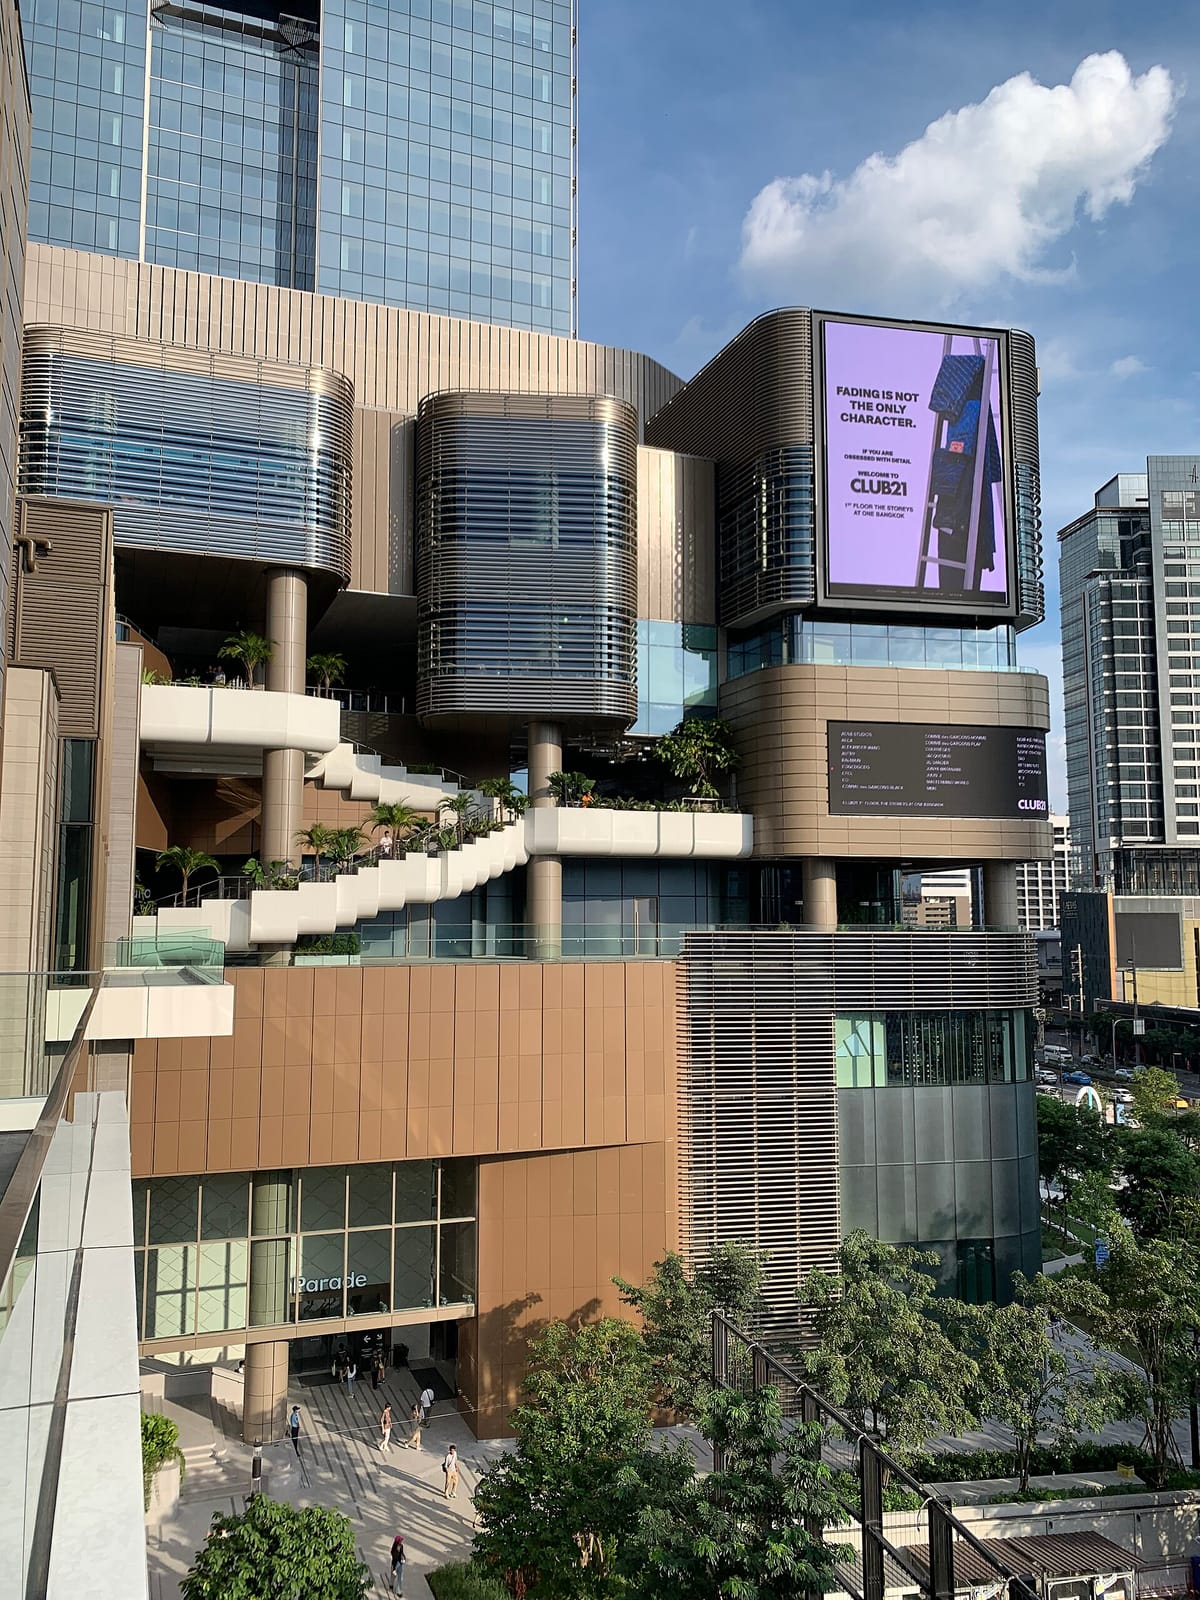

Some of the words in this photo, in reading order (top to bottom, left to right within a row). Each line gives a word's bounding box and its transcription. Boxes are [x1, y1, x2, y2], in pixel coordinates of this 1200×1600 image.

[836, 386, 880, 399] FADING
[882, 390, 893, 400] IS
[895, 391, 920, 402] NOT
[850, 400, 874, 411] THE
[876, 403, 906, 414] ONLY
[840, 412, 917, 428] CHARACTER.
[858, 470, 890, 478] WELCOME
[850, 478, 907, 496] CLUB21
[876, 511, 905, 519] BANGKOK
[1018, 799, 1046, 811] CLUB21
[294, 1271, 368, 1293] Parade
